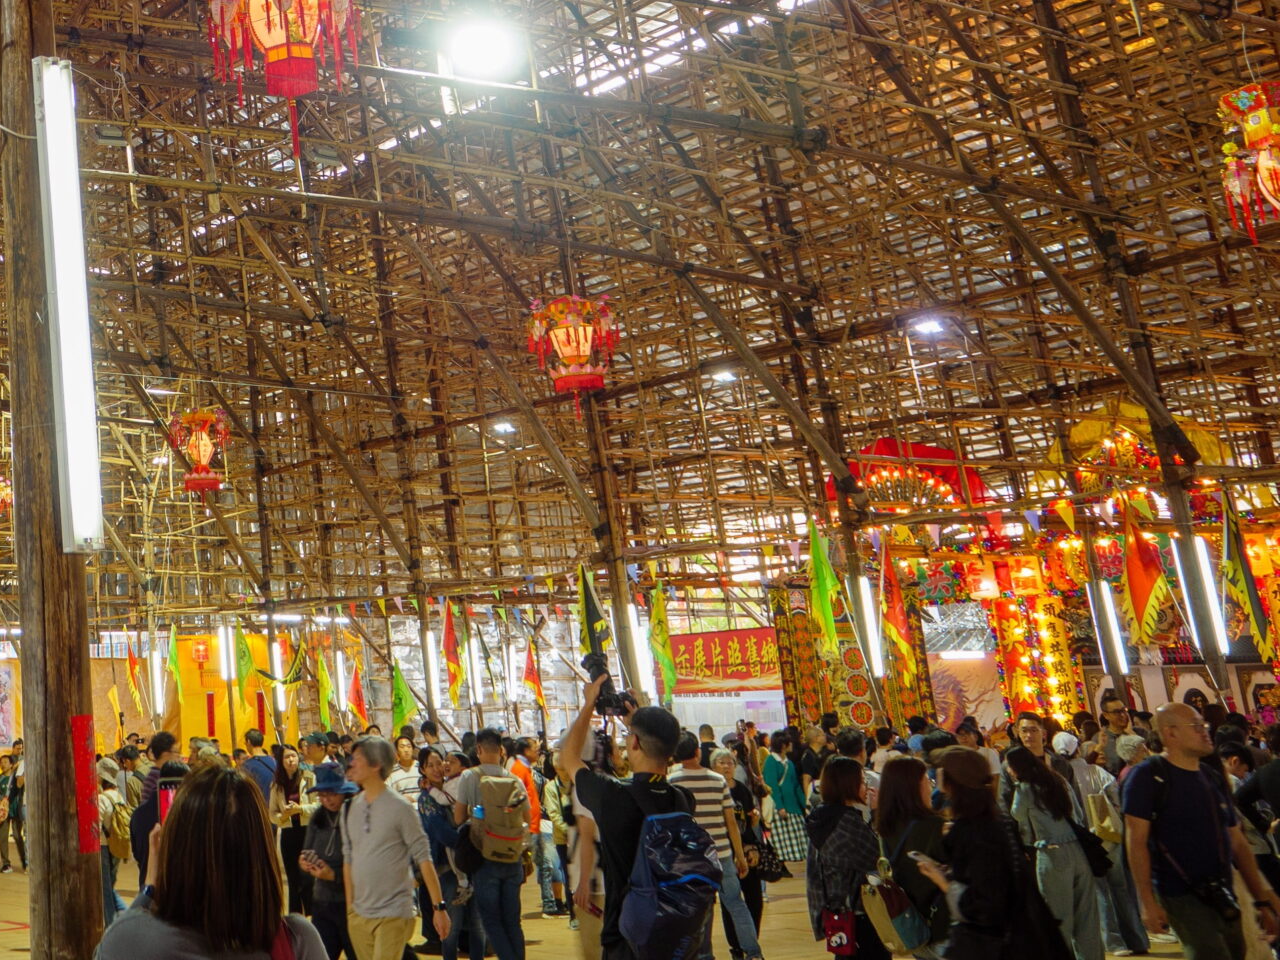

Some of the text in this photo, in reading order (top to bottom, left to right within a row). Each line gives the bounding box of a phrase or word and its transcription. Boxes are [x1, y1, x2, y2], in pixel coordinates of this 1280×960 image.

[674, 635, 780, 681] 鄉舊照片展示
